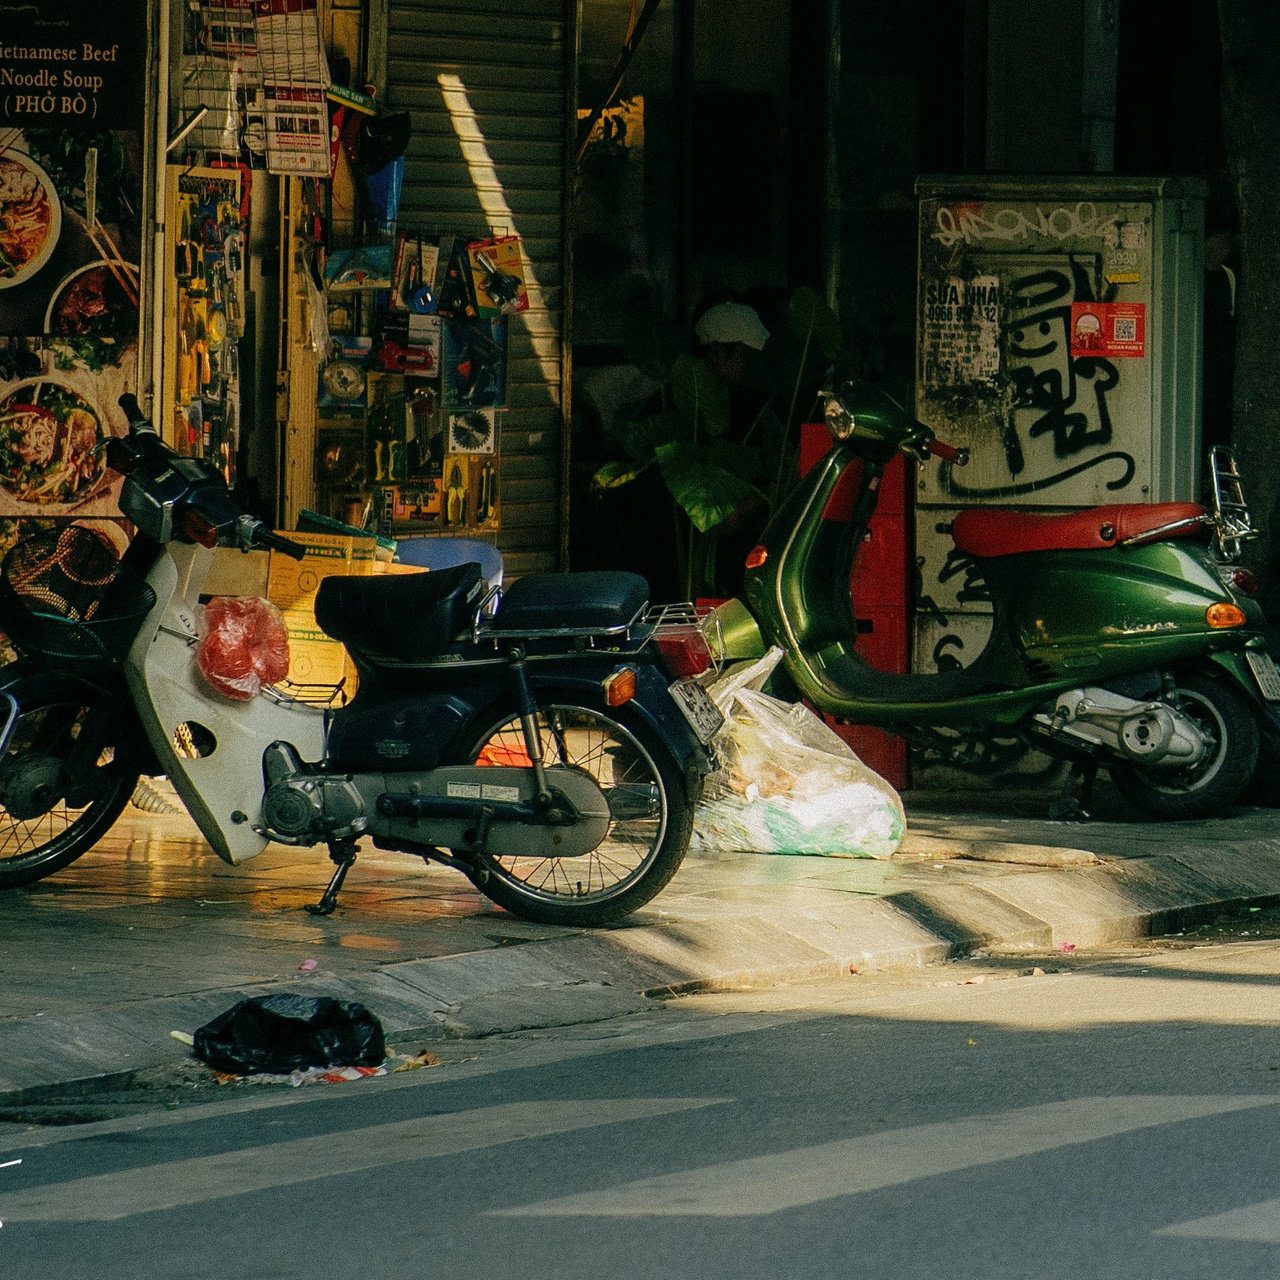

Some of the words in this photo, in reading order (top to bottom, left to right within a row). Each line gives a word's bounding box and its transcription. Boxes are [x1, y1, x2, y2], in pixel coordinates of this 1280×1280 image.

[82, 43, 119, 62] Beef
[1, 68, 58, 87] Noodle
[63, 70, 103, 93] Soup
[15, 90, 56, 113] PHỞ
[61, 92, 88, 114] BÒ
